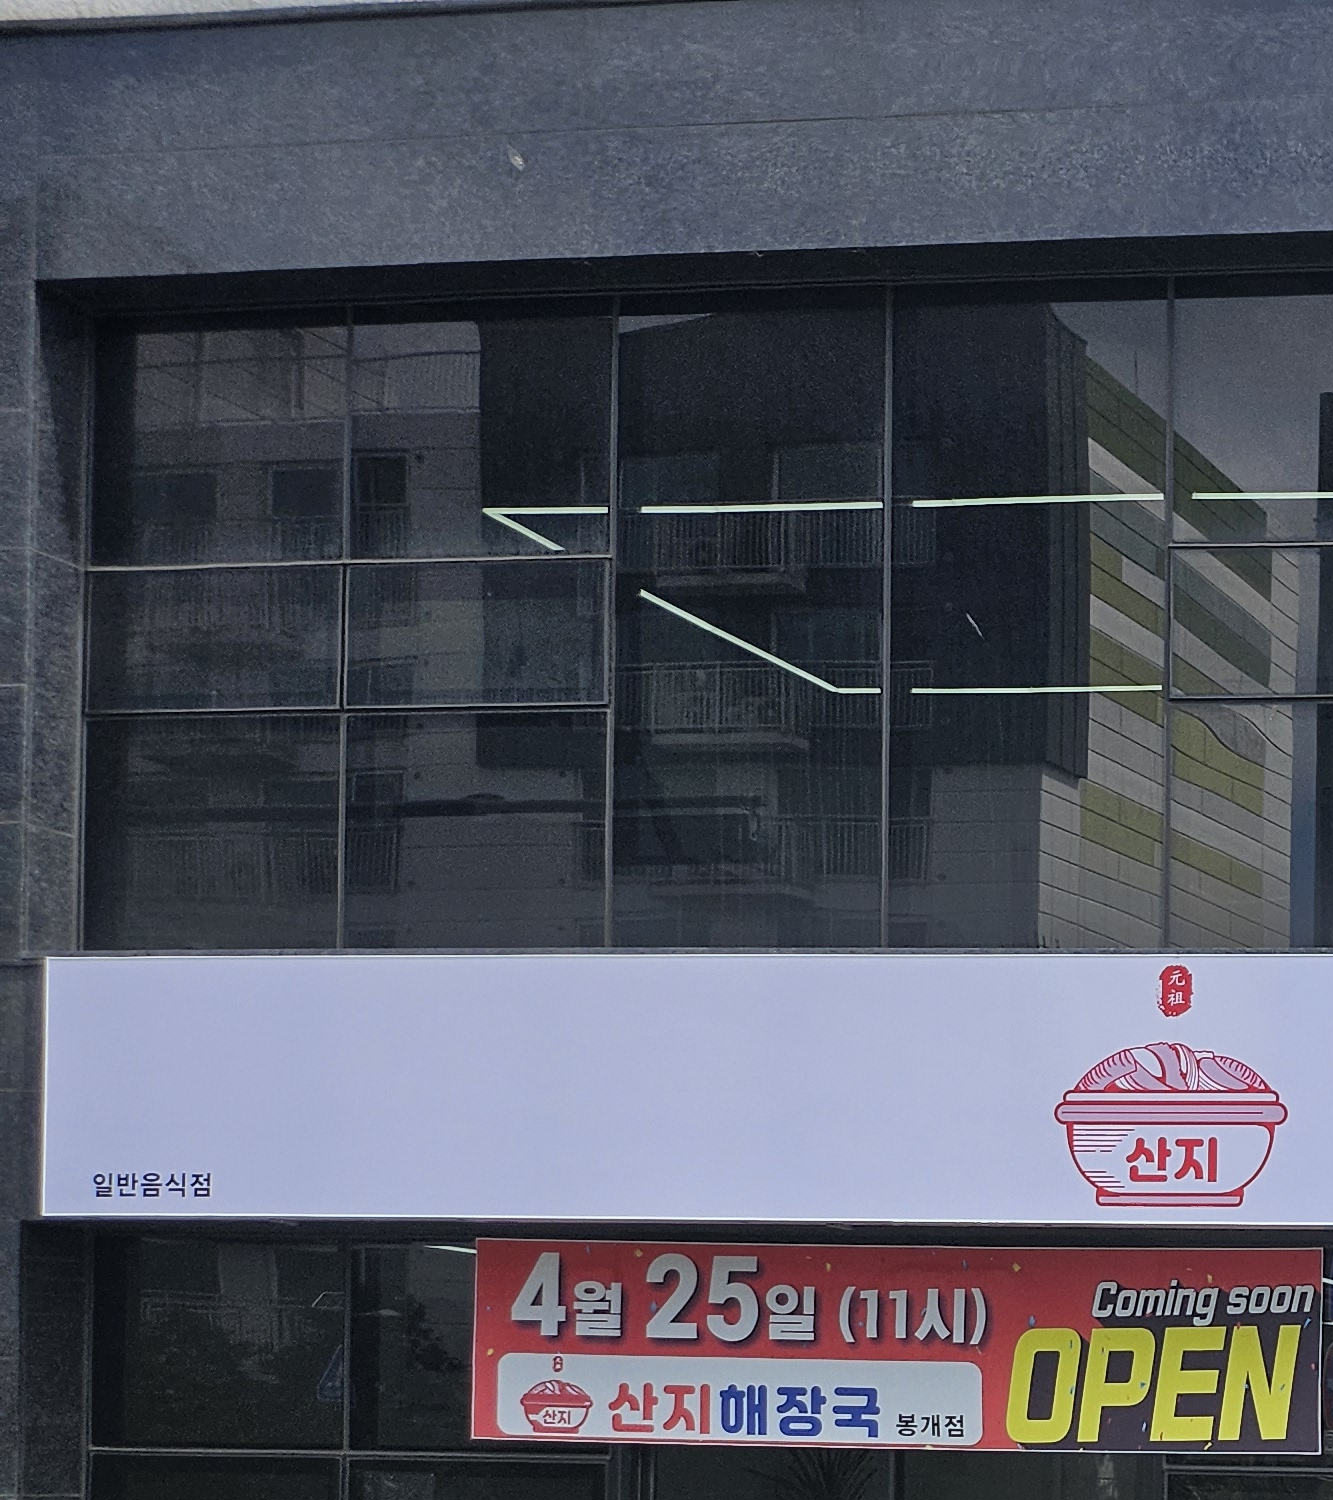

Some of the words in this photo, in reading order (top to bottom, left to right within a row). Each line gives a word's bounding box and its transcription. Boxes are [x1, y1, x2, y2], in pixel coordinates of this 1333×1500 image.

[1158, 969, 1186, 1006] 元祖
[1125, 1136, 1218, 1183] 산지
[93, 1172, 211, 1197] 일반음식점
[510, 1251, 624, 1339] 4월
[645, 1256, 815, 1343] 25일
[837, 1284, 987, 1347] (11시)
[1092, 1281, 1218, 1326] Coming
[1226, 1284, 1316, 1316] soon
[1005, 1325, 1300, 1445] OPEN
[542, 1409, 572, 1426] 산지
[608, 1381, 882, 1439] 산지해장국
[896, 1413, 965, 1438] 봉개점
